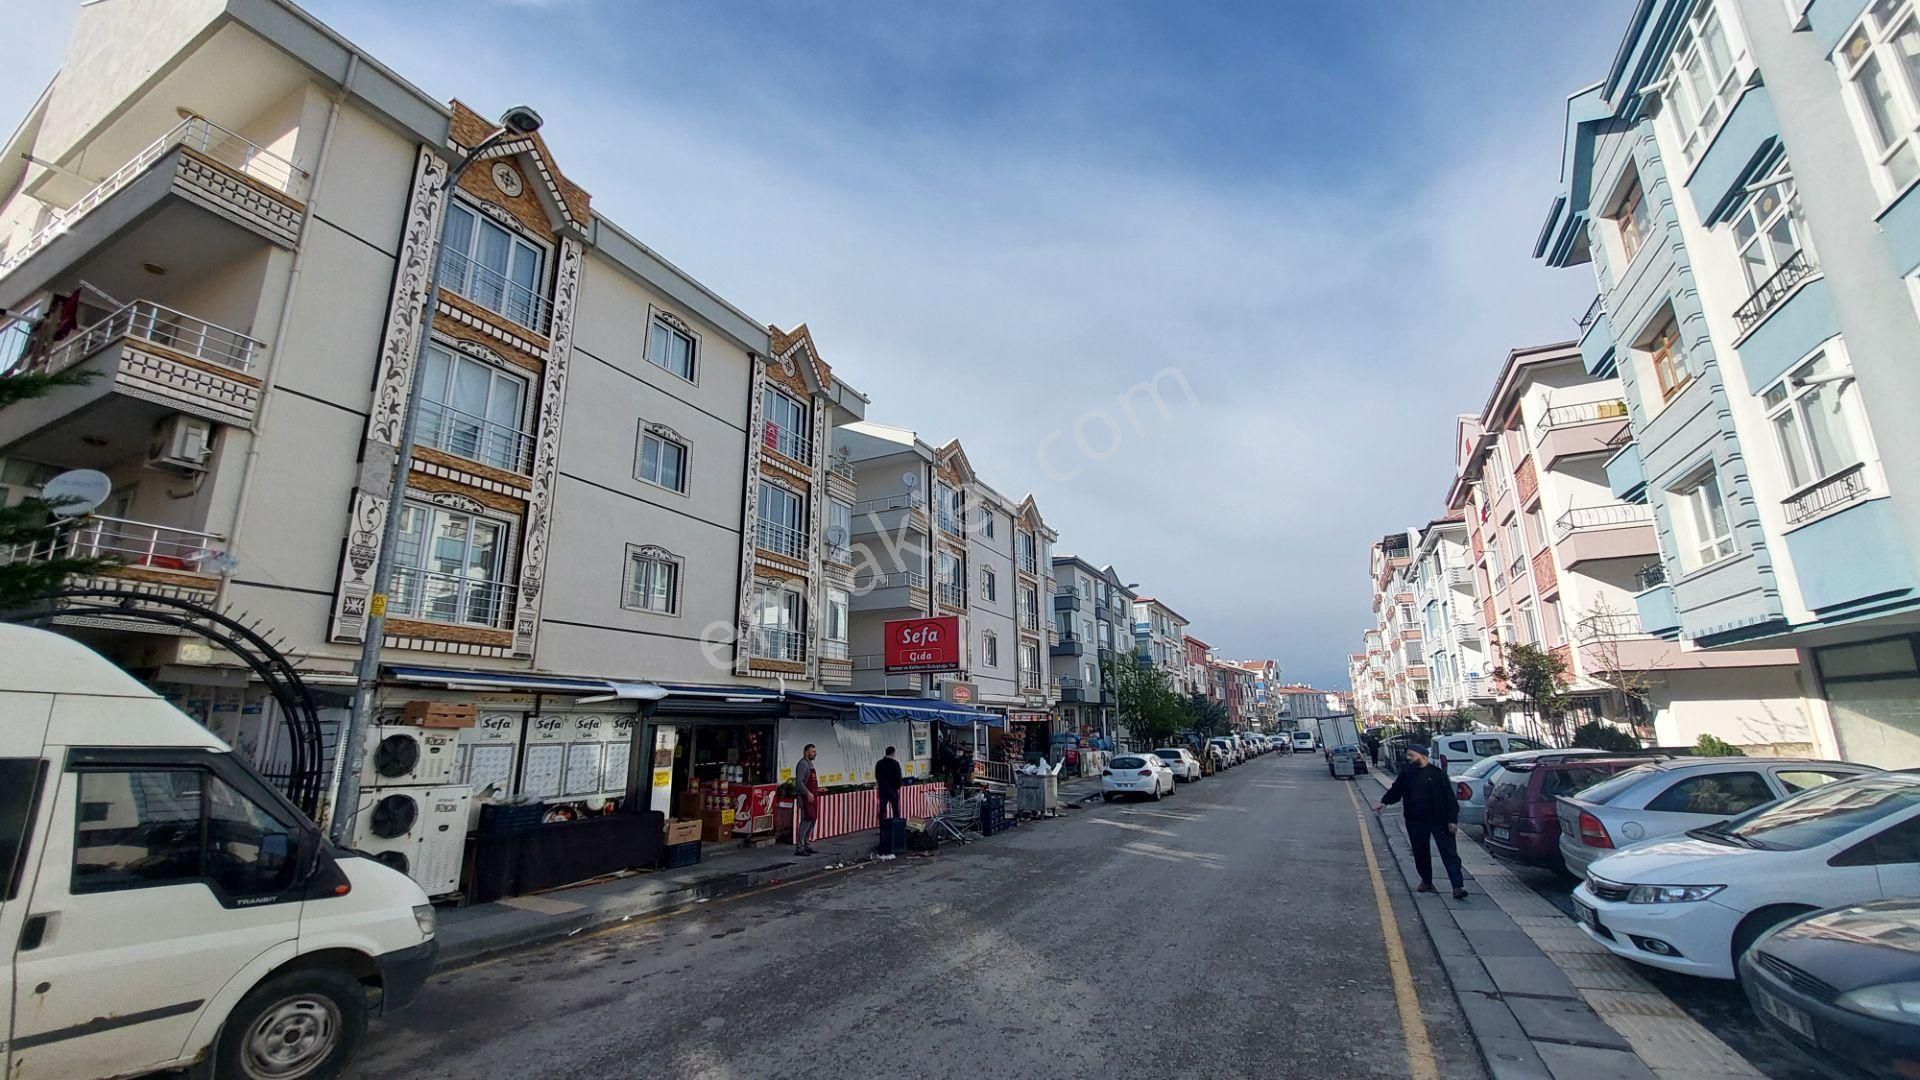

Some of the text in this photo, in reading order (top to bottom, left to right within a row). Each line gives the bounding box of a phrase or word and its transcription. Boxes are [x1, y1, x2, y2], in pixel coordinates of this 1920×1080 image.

[902, 626, 938, 647] Sefa
[909, 651, 932, 662] Gıda
[483, 718, 511, 731] Sefa
[537, 720, 561, 731] Sefa
[578, 719, 600, 730] Sefa
[614, 719, 634, 730] Sefa
[236, 895, 278, 905] TRANSIT
